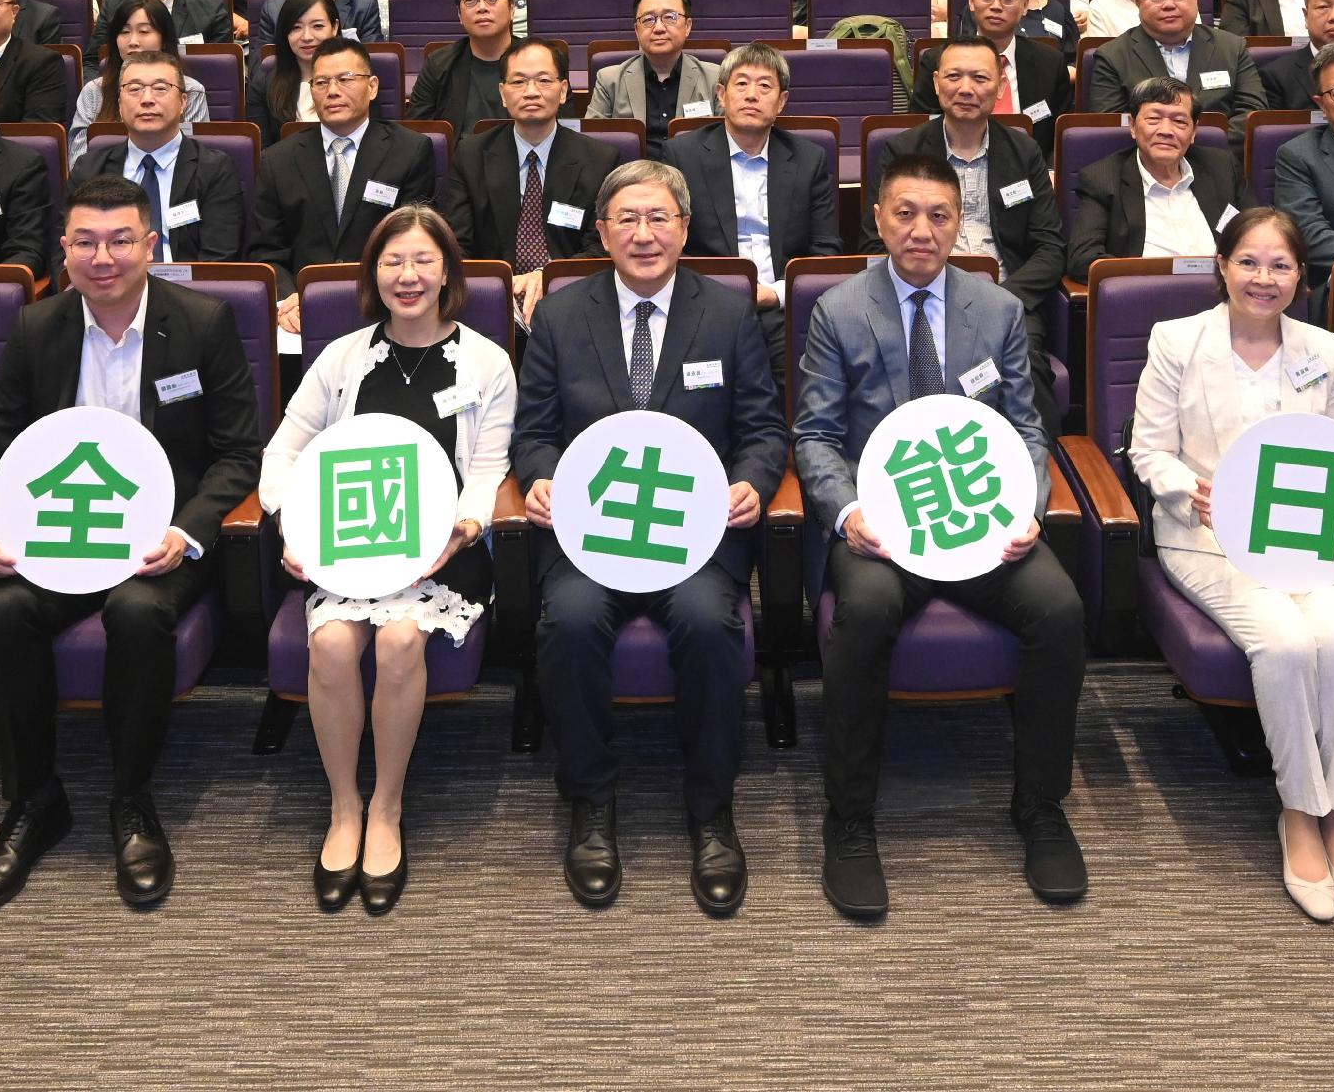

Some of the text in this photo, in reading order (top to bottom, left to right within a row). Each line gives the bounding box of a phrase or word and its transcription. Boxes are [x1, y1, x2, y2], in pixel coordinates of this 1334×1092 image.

[25, 441, 140, 560] 全
[319, 443, 422, 567] 國
[582, 446, 695, 564] 生
[884, 420, 1015, 557] 態
